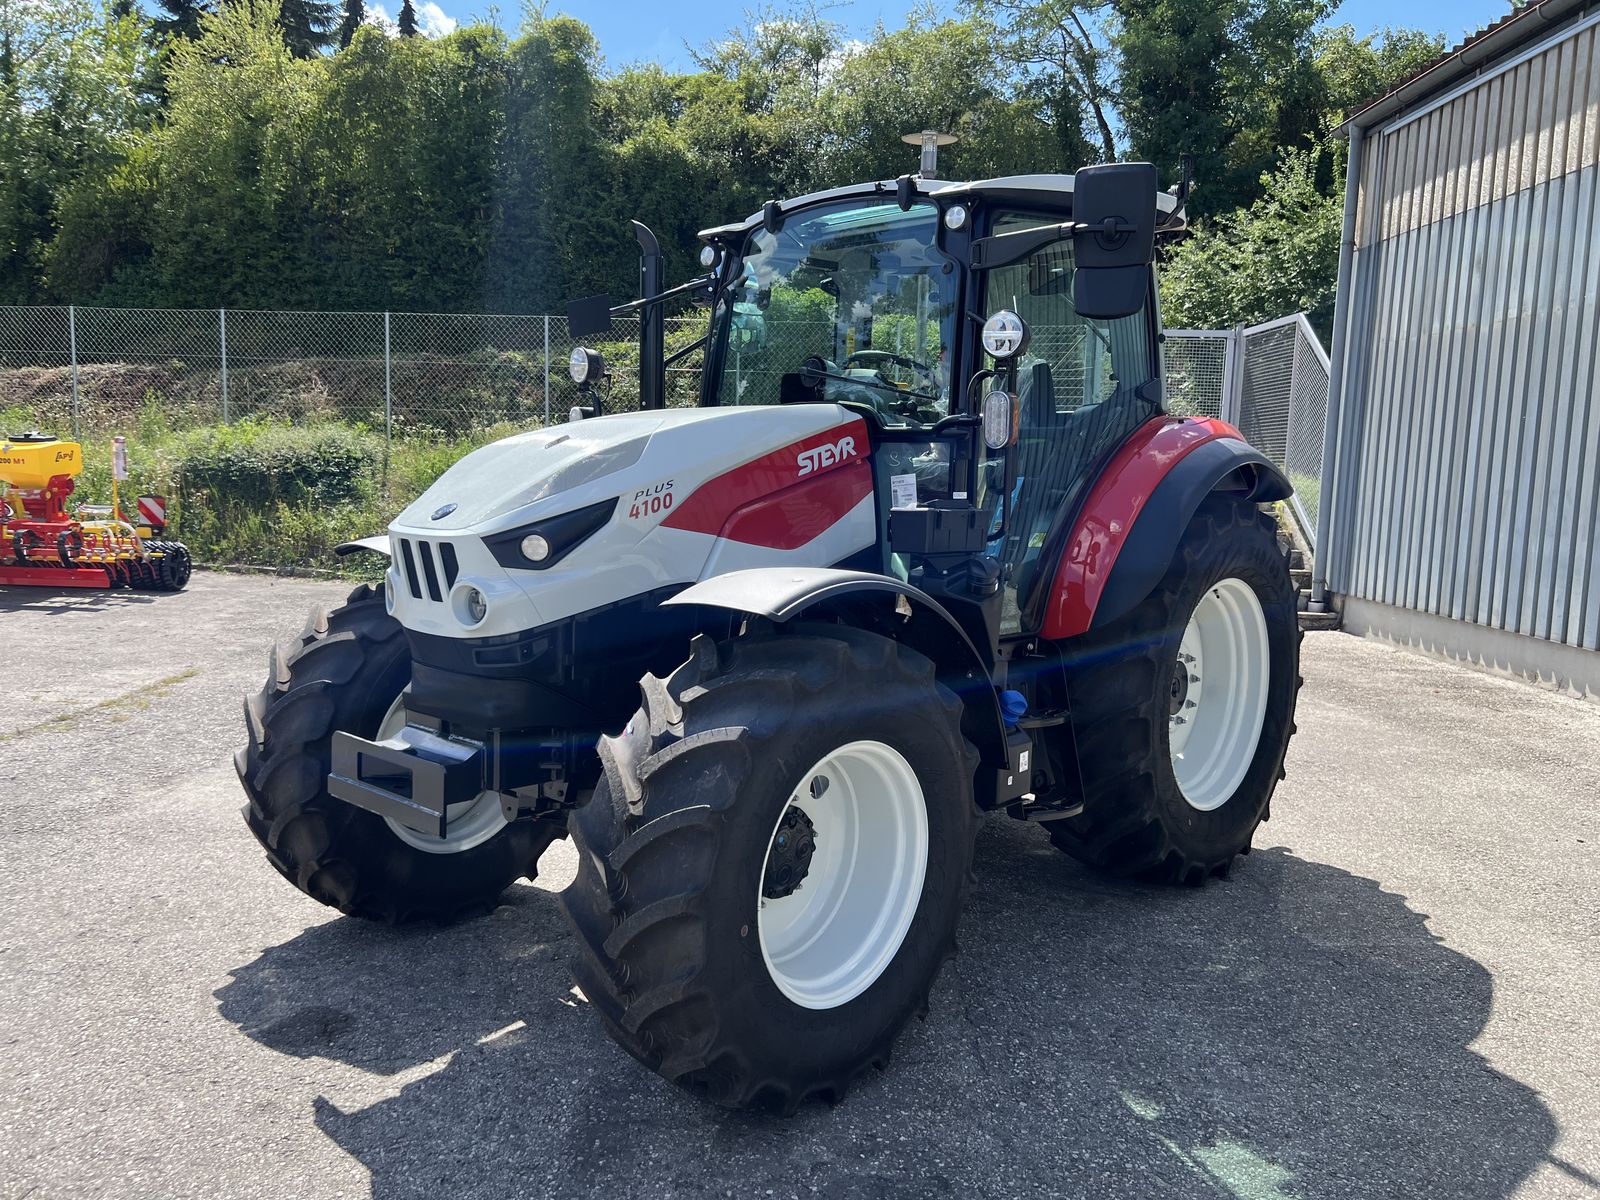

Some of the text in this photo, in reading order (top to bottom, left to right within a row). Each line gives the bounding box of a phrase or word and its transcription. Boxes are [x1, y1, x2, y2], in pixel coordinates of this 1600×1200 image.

[797, 436, 857, 476] STEYR
[634, 479, 674, 501] PLUS
[629, 492, 673, 520] 4100
